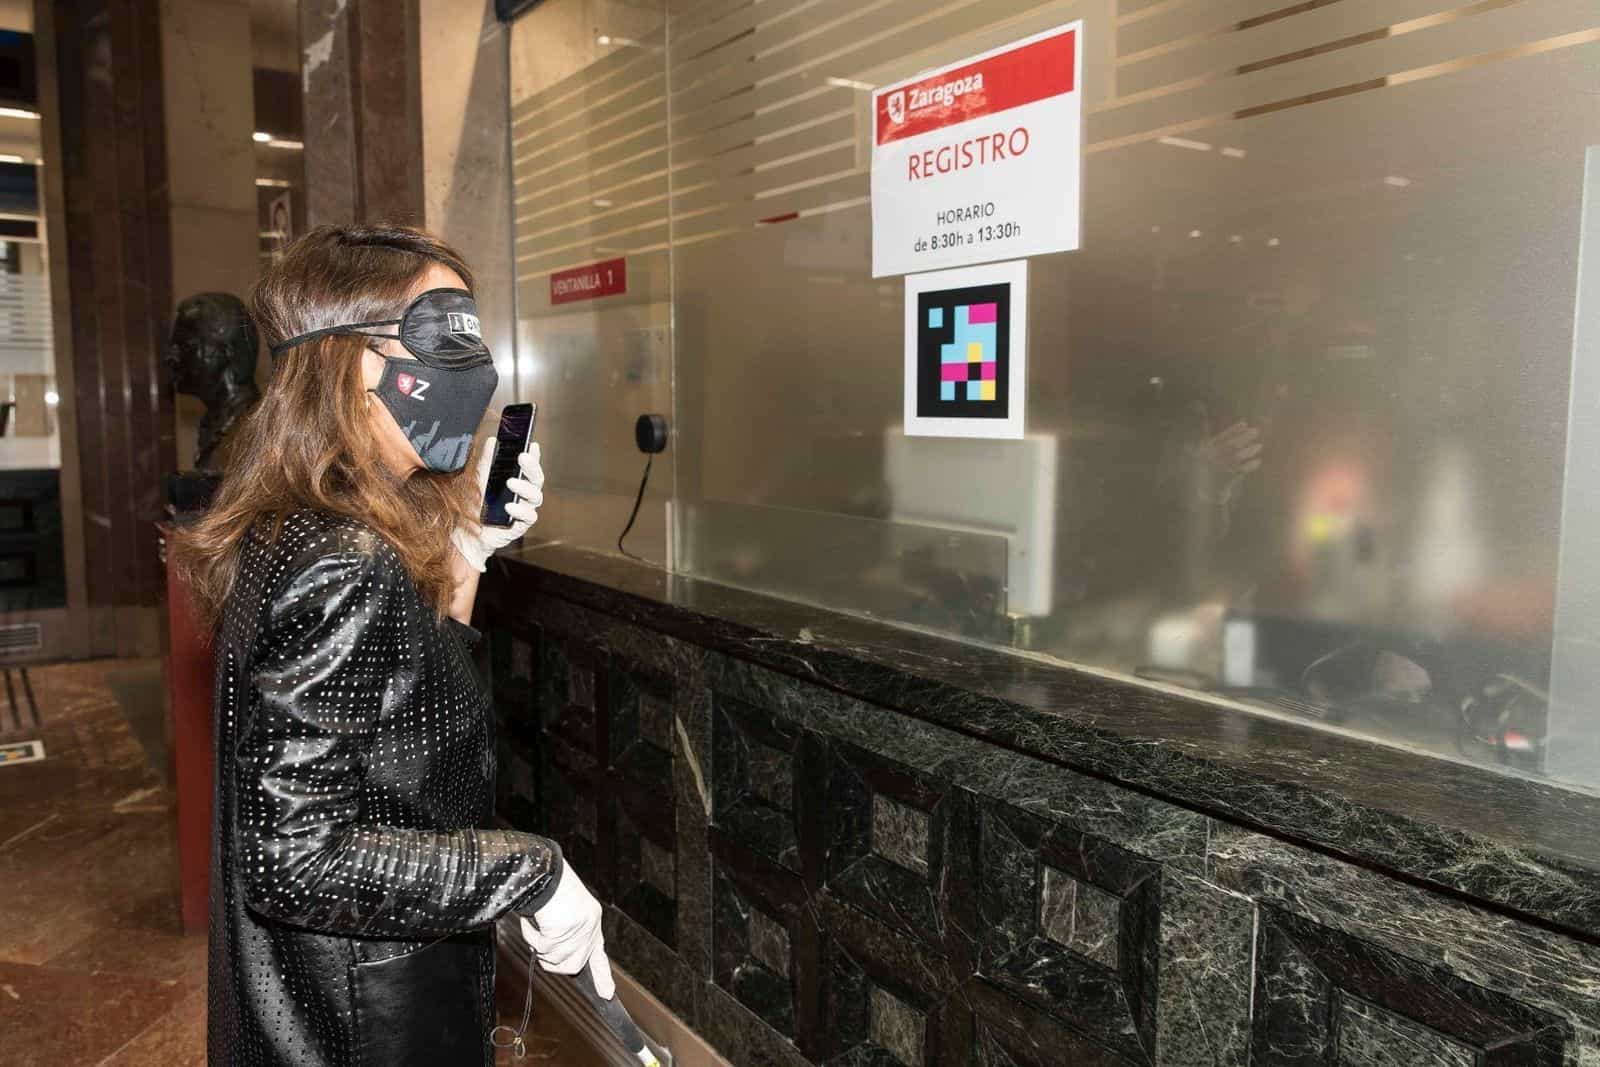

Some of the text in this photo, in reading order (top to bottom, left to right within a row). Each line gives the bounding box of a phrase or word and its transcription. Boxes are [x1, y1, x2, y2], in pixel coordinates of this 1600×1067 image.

[909, 73, 984, 110] Zaragoza
[908, 127, 1030, 181] REGISTRO
[937, 202, 995, 226] HORARIO
[914, 222, 1021, 252] de 8:30h a 13:30h
[607, 268, 614, 286] 1
[410, 379, 431, 401] Z
